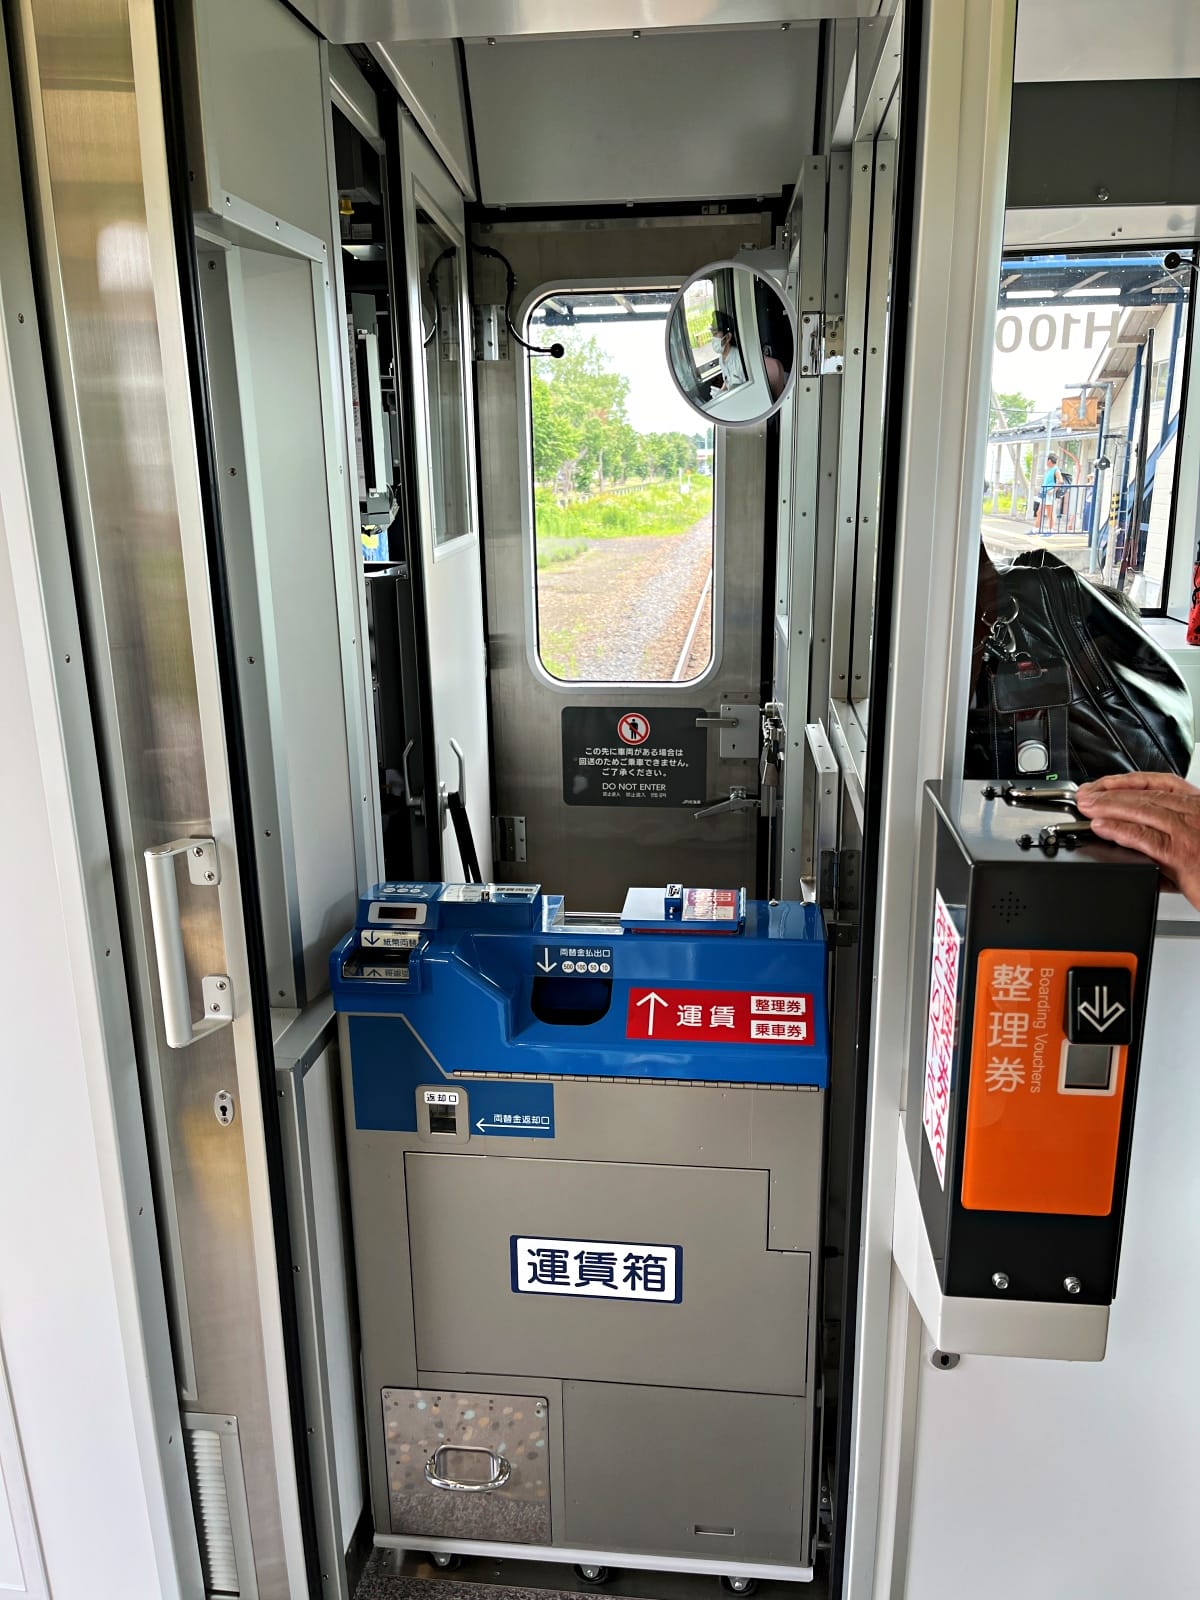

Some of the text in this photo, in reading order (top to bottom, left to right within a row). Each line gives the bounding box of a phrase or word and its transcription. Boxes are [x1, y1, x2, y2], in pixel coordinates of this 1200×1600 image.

[585, 747, 684, 757] この先に車両がある場合は
[578, 757, 689, 768] 回送のためご乗車できません。
[602, 768, 667, 777] ご了承ください。
[602, 782, 666, 792] DO NOT ENTER
[560, 948, 611, 958] 両替金払出口
[755, 999, 801, 1013] 整理券
[676, 1004, 736, 1029] 運賃
[755, 1023, 802, 1038] 乗車券
[984, 964, 1034, 1094] 整理券
[1029, 967, 1055, 1094] Boarding Vouchers
[426, 1093, 457, 1103] 返却口
[493, 1113, 550, 1125] 両替金返却口
[527, 1248, 668, 1292] 運賃箱
